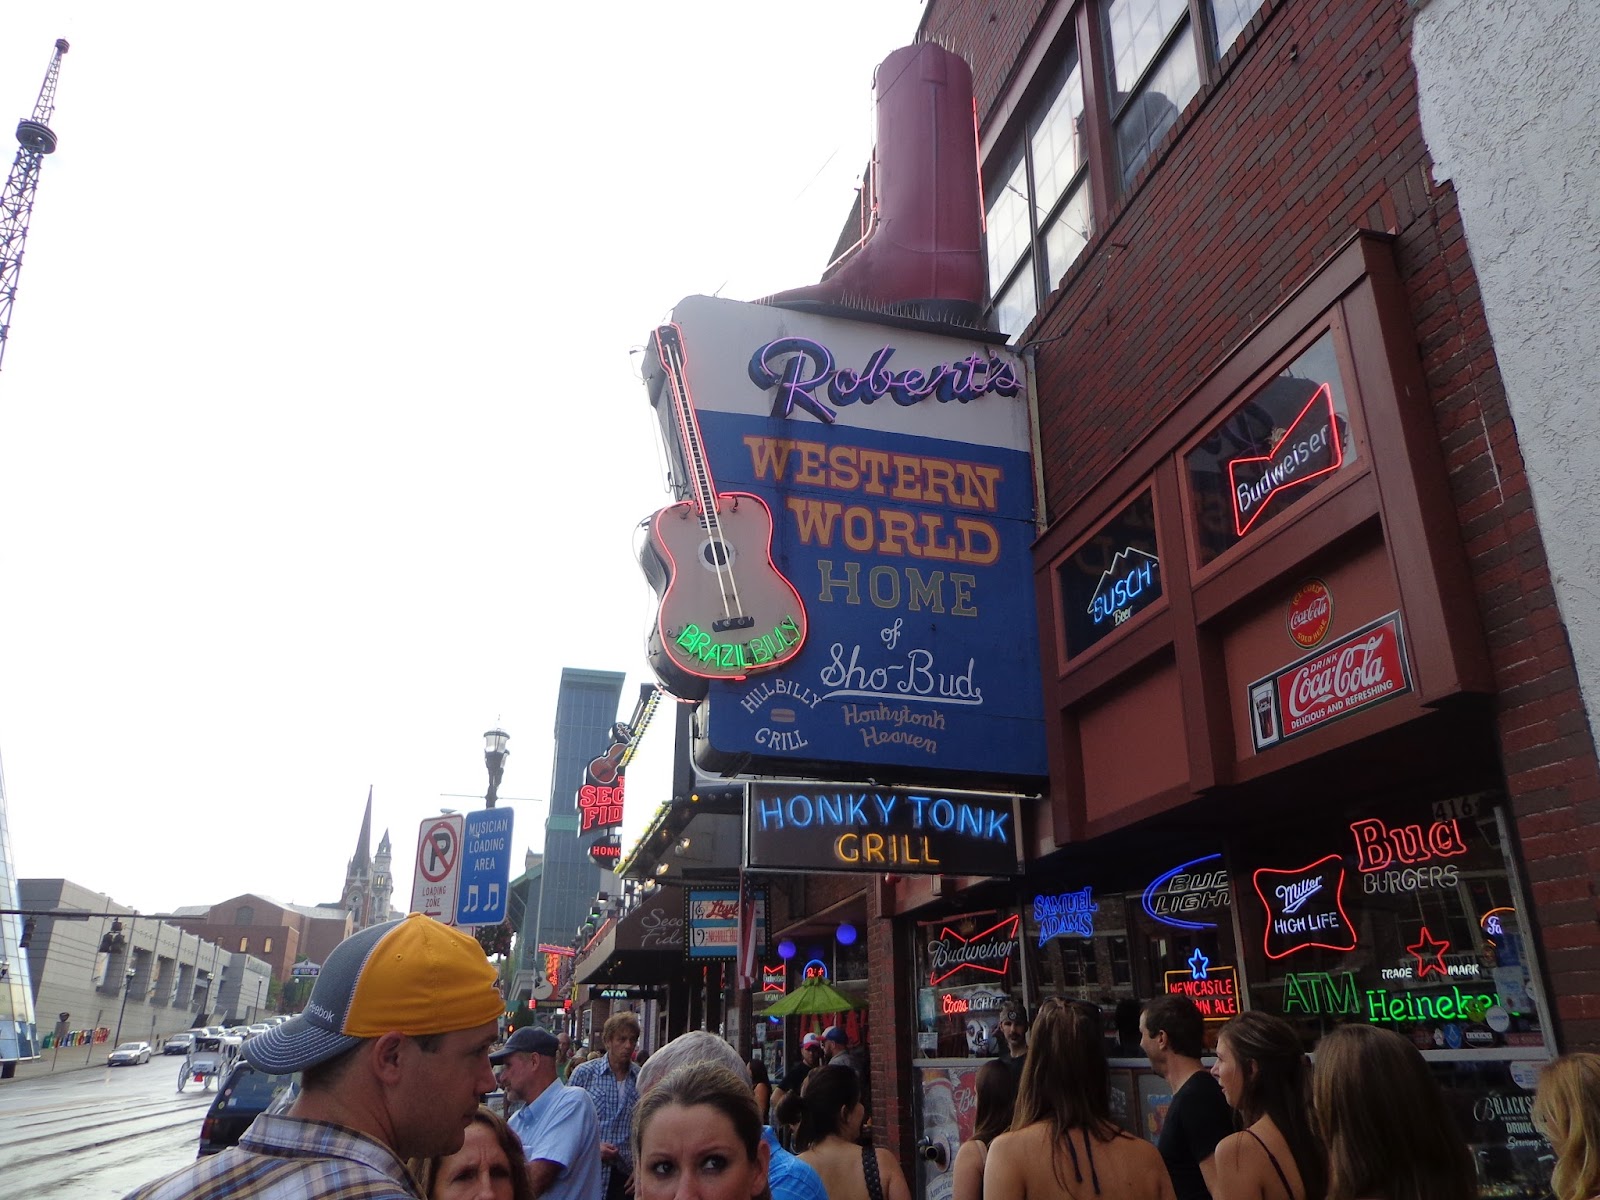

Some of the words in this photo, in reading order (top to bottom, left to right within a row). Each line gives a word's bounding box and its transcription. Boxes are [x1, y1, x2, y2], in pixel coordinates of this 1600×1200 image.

[748, 336, 1027, 424] Robert's
[743, 434, 1005, 511] WESTERN
[1237, 424, 1332, 515] Budweiser
[787, 497, 1001, 565] WORLD
[817, 559, 978, 617] HOME
[1092, 560, 1153, 625] BUSCH
[1303, 584, 1322, 594] COLD
[1113, 603, 1134, 628] Beer
[1290, 594, 1328, 631] Coca-Cola
[880, 617, 903, 650] of
[1297, 632, 1313, 643] SOLD
[1312, 619, 1328, 640] HERE
[819, 643, 984, 703] Sho-Bud
[1309, 652, 1338, 674] DRINK
[740, 678, 822, 714] HILLBILLY
[1291, 708, 1326, 730] DELICIOUS
[1327, 700, 1344, 714] AND
[1345, 679, 1394, 706] REFRESHING
[754, 727, 809, 751] GRILL
[859, 726, 938, 754] Heaven
[580, 785, 625, 807] SEC
[1435, 797, 1473, 818] 416
[468, 818, 509, 836] MUSICIAN
[583, 806, 623, 829] FID
[758, 793, 896, 833] HONKY
[905, 796, 1010, 843] TONK
[469, 837, 505, 854] LOADING
[593, 846, 621, 856] HONK
[834, 832, 940, 866] GRILL
[1349, 817, 1468, 874] Bud
[474, 857, 496, 871] AREA
[1362, 864, 1460, 894] BURGERS
[422, 886, 446, 897] LOADING
[425, 897, 441, 908] ZONE
[1034, 886, 1098, 921] SAMUEL
[1275, 875, 1323, 908] Miller
[641, 908, 683, 929] Seco
[1038, 912, 1093, 948] ADAMS
[1274, 916, 1307, 934] HIGH
[1307, 912, 1339, 930] LIFE
[1487, 915, 1504, 935] Fa
[928, 936, 1018, 968] Budweiser
[1381, 966, 1413, 980] TRADE
[1447, 963, 1480, 977] MARK
[600, 989, 628, 999] ATM
[1170, 978, 1233, 997] NEWCASTLE
[1282, 971, 1361, 1015] ATM
[942, 993, 968, 1014] Coors
[1214, 998, 1236, 1014] ALE
[1493, 1094, 1538, 1115] BLACKS
[1506, 1122, 1533, 1134] DRINK
